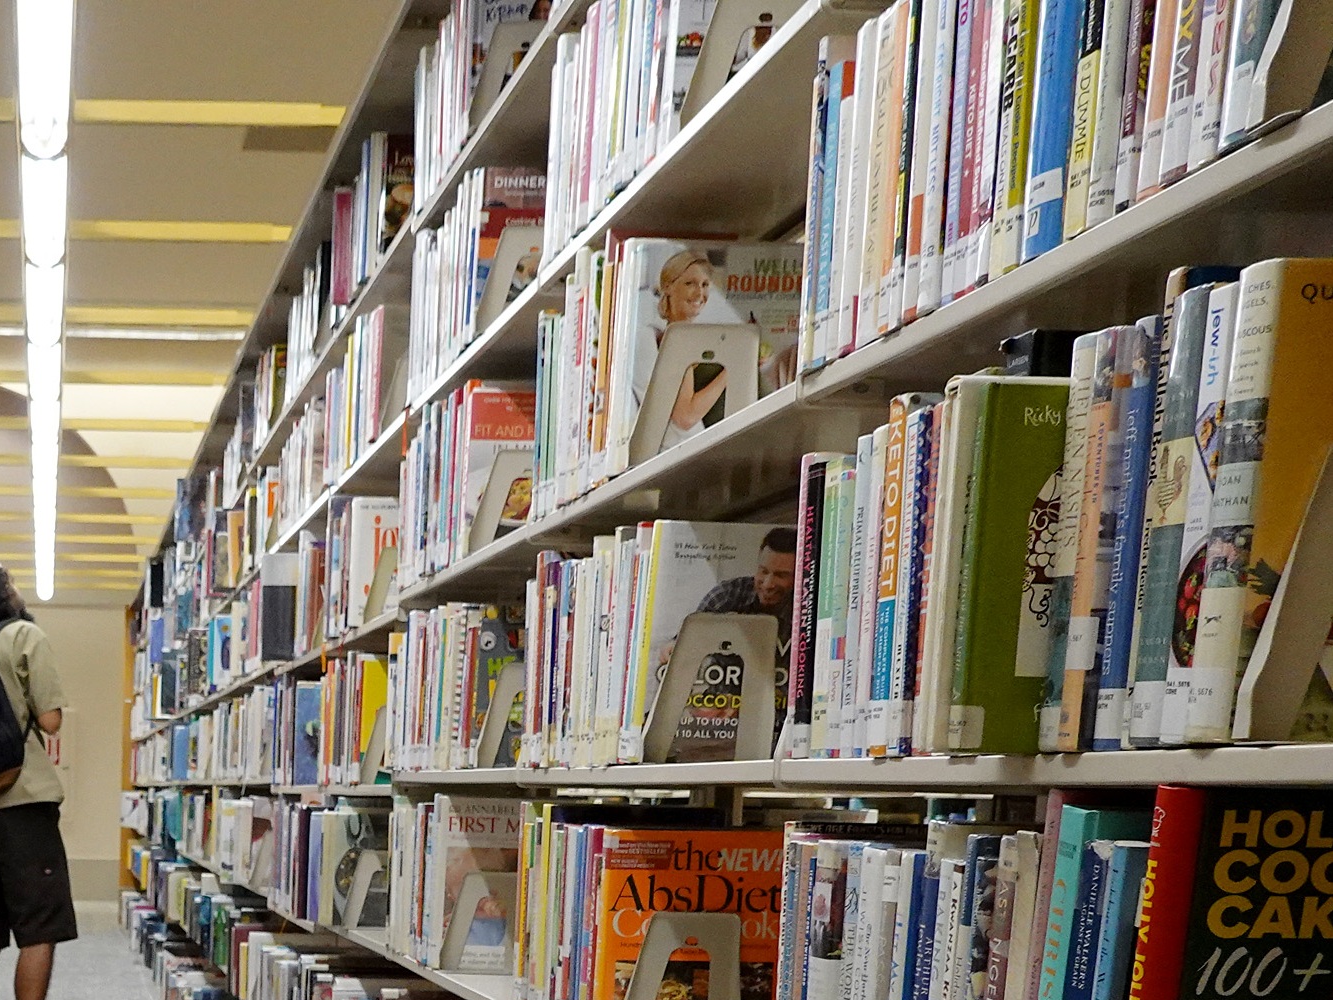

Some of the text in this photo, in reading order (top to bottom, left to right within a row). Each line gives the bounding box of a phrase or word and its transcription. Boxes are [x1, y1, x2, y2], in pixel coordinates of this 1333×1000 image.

[930, 124, 941, 151] NOT
[965, 83, 977, 160] KETO DIET
[1073, 75, 1092, 161] DUMMIE
[927, 154, 938, 194] LESS
[495, 423, 525, 437] AND
[1024, 404, 1062, 427] Ricky
[880, 418, 904, 593] KETO DIET
[1102, 408, 1141, 677] jeff nathan's family suppers
[795, 504, 816, 698] HEALTHY LATIN COOKING
[850, 549, 863, 612] BLUEPRINT
[680, 716, 722, 727] UP TO 10
[685, 693, 726, 708] OCCO
[681, 729, 735, 739] 10 ALL YOU
[448, 815, 500, 833] FIRST
[674, 840, 723, 872] the
[719, 847, 782, 872] NEW!
[1077, 864, 1102, 990] DANIELLE WALKER'S
[1137, 858, 1159, 943] HOLLY
[912, 922, 926, 979] Jewish
[944, 897, 958, 973] KWANZAA
[919, 936, 934, 997] ARTHUR
